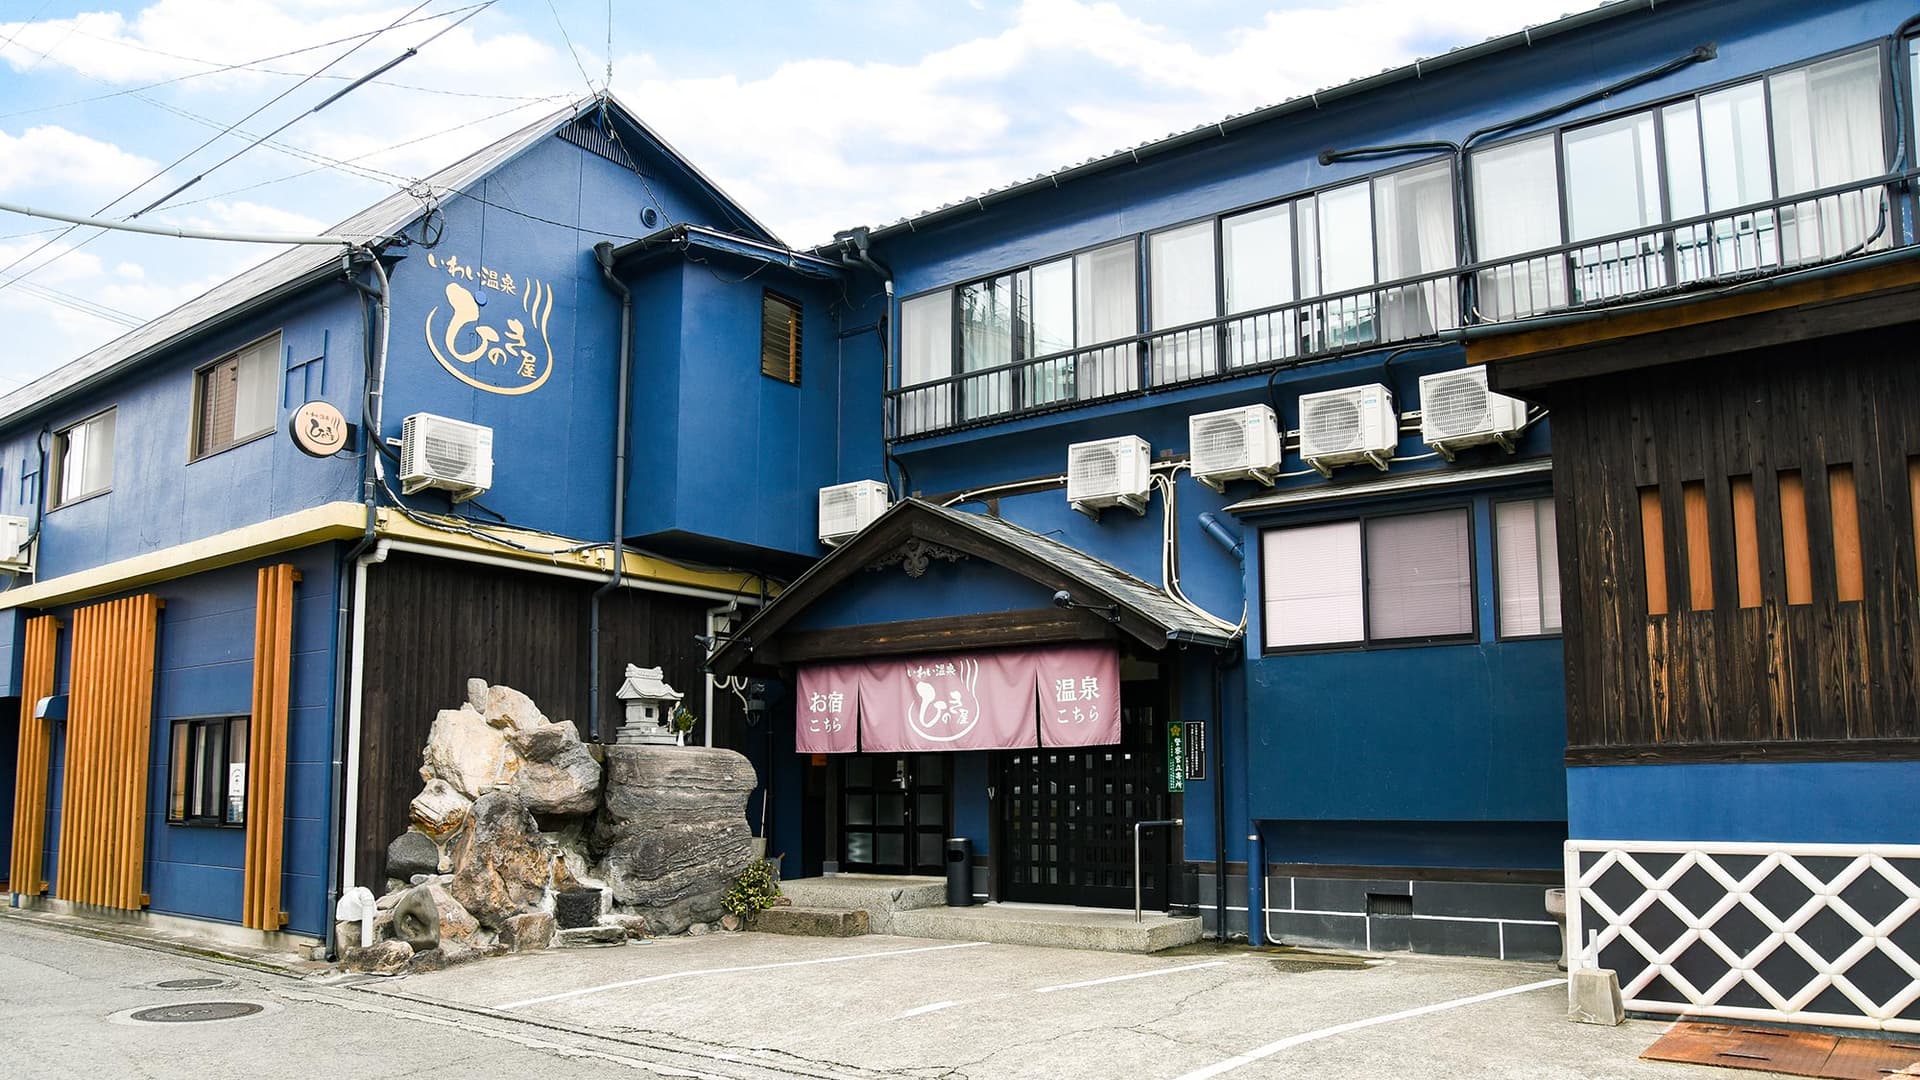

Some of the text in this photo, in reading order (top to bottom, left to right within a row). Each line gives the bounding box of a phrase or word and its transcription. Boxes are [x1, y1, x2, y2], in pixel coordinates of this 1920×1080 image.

[428, 253, 516, 295] いわい温泉
[446, 283, 537, 379] ひのき屋
[907, 663, 957, 678] いわい温泉
[1056, 676, 1100, 702] 温泉
[810, 691, 844, 713] お宿
[916, 681, 969, 728] ひのき屋
[810, 717, 841, 733] こちら
[1057, 705, 1099, 724] こちら
